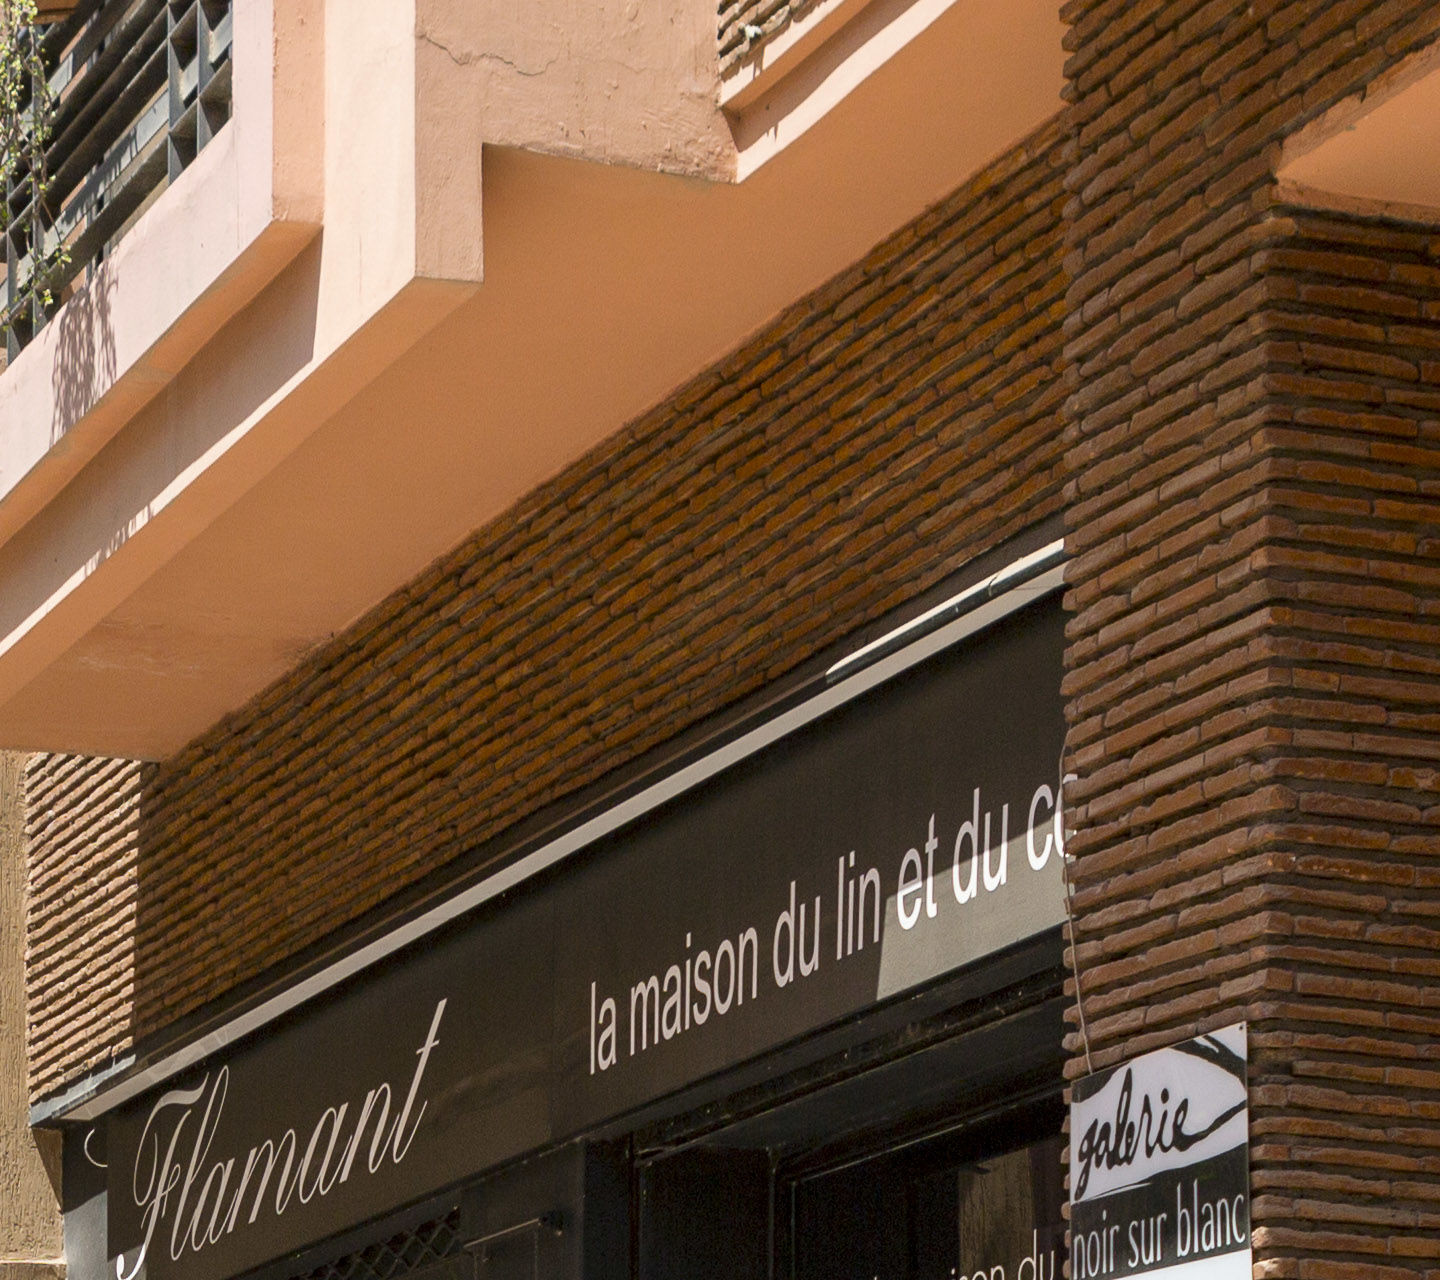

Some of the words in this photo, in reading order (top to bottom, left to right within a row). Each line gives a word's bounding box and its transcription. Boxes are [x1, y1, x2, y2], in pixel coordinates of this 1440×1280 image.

[590, 981, 616, 1075] la
[629, 932, 757, 1057] maison
[772, 880, 820, 988] du
[835, 851, 880, 961] lin
[896, 813, 938, 930] et
[952, 787, 1009, 905] du
[1074, 1067, 1220, 1200] galerie
[1073, 1211, 1119, 1280] noir
[1128, 1210, 1167, 1269] sur
[1177, 1179, 1245, 1257] blanc
